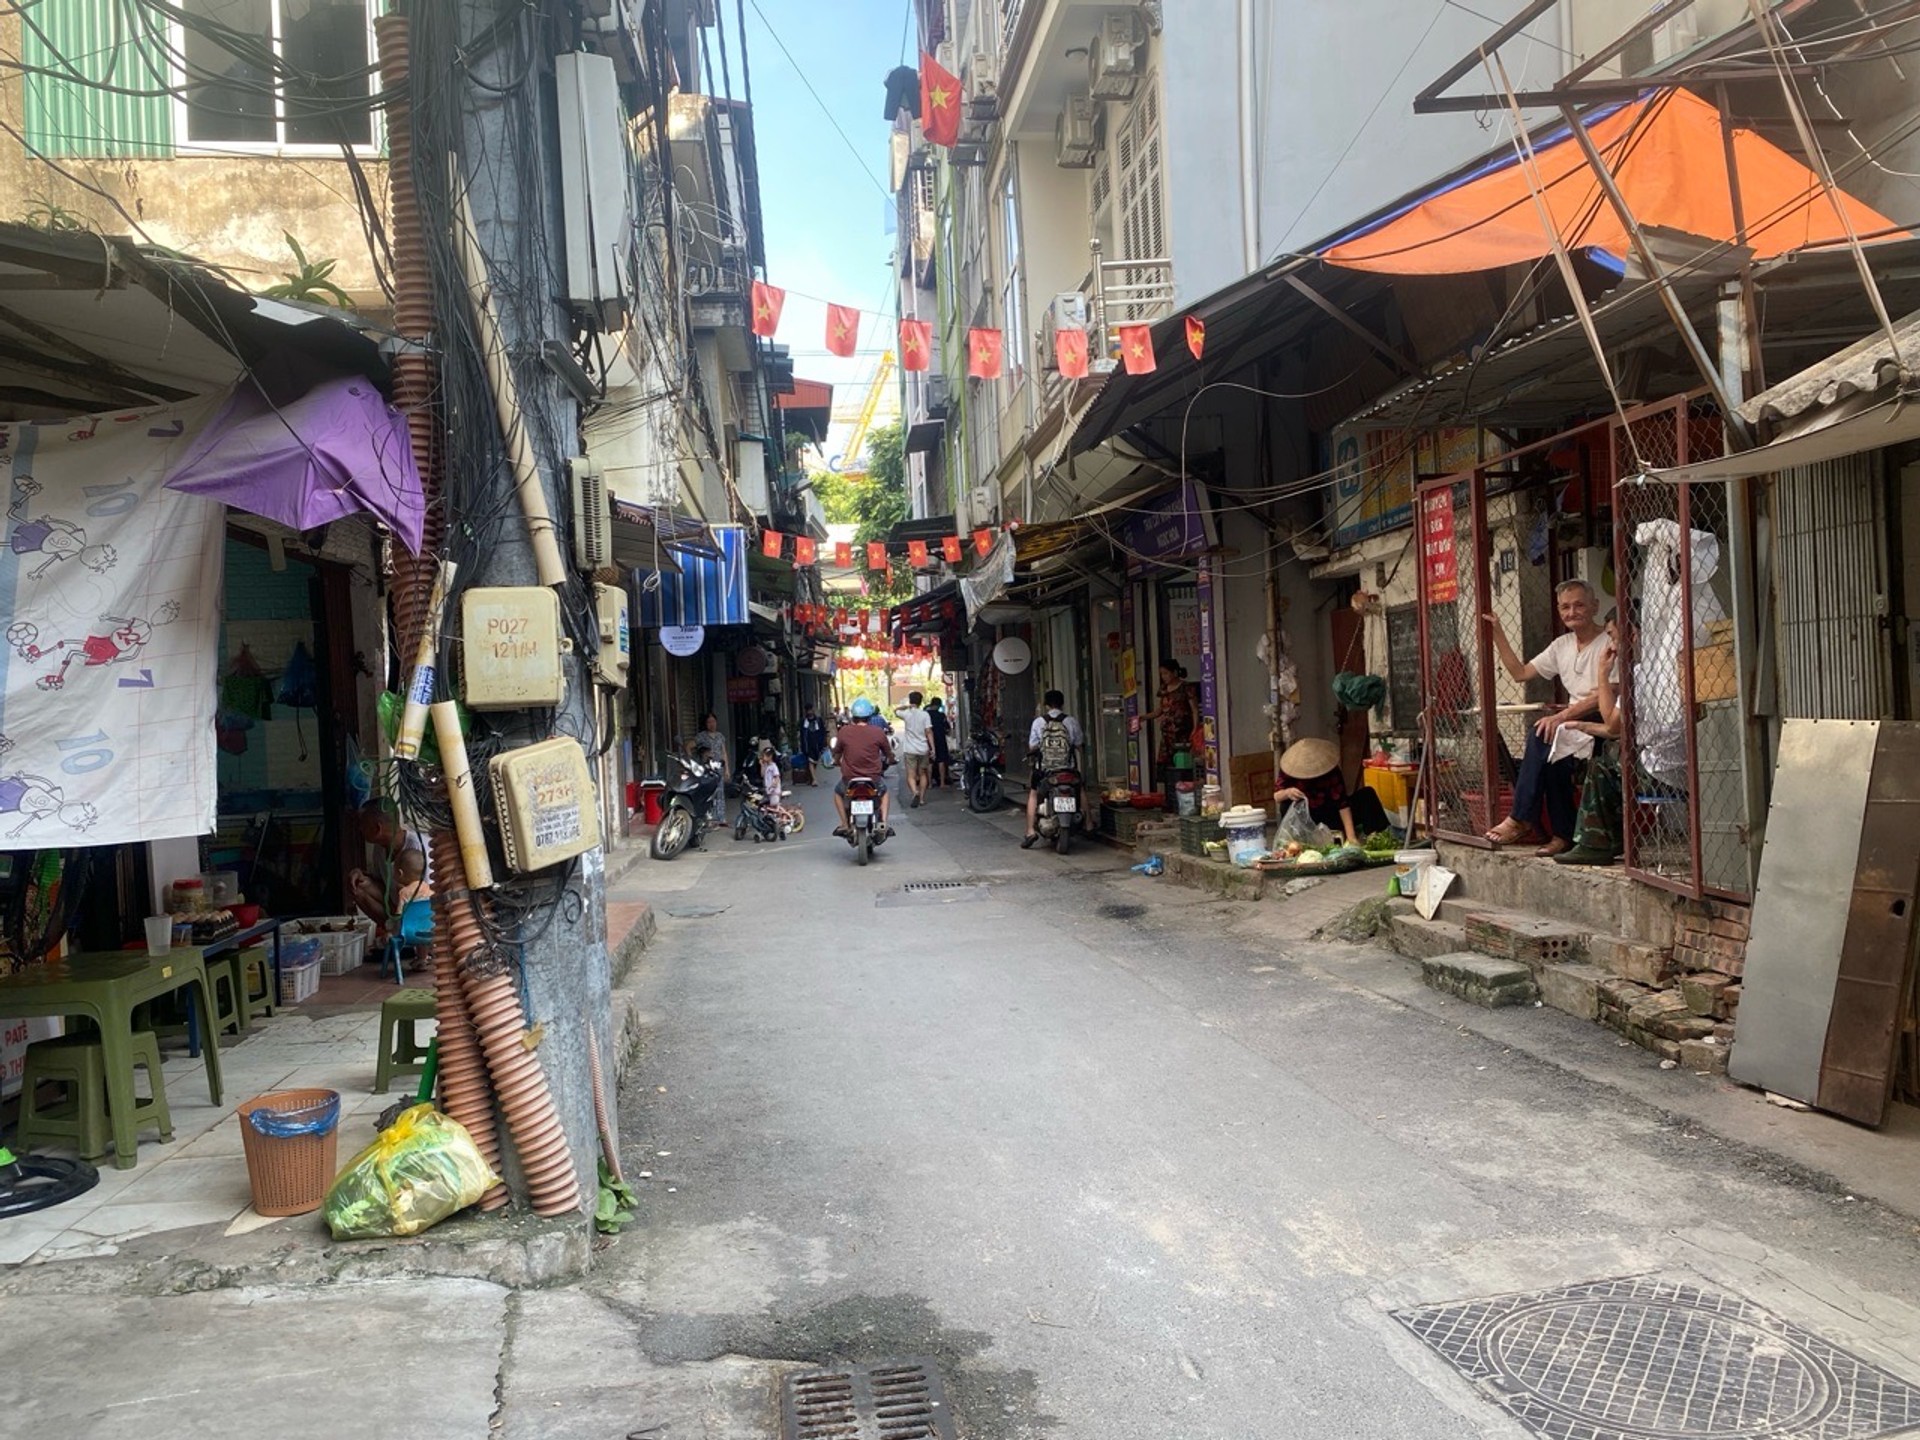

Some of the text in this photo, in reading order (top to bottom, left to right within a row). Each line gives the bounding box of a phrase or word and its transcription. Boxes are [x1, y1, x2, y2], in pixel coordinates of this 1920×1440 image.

[487, 618, 529, 635] P027
[117, 668, 155, 688] 1
[54, 728, 115, 775] 10
